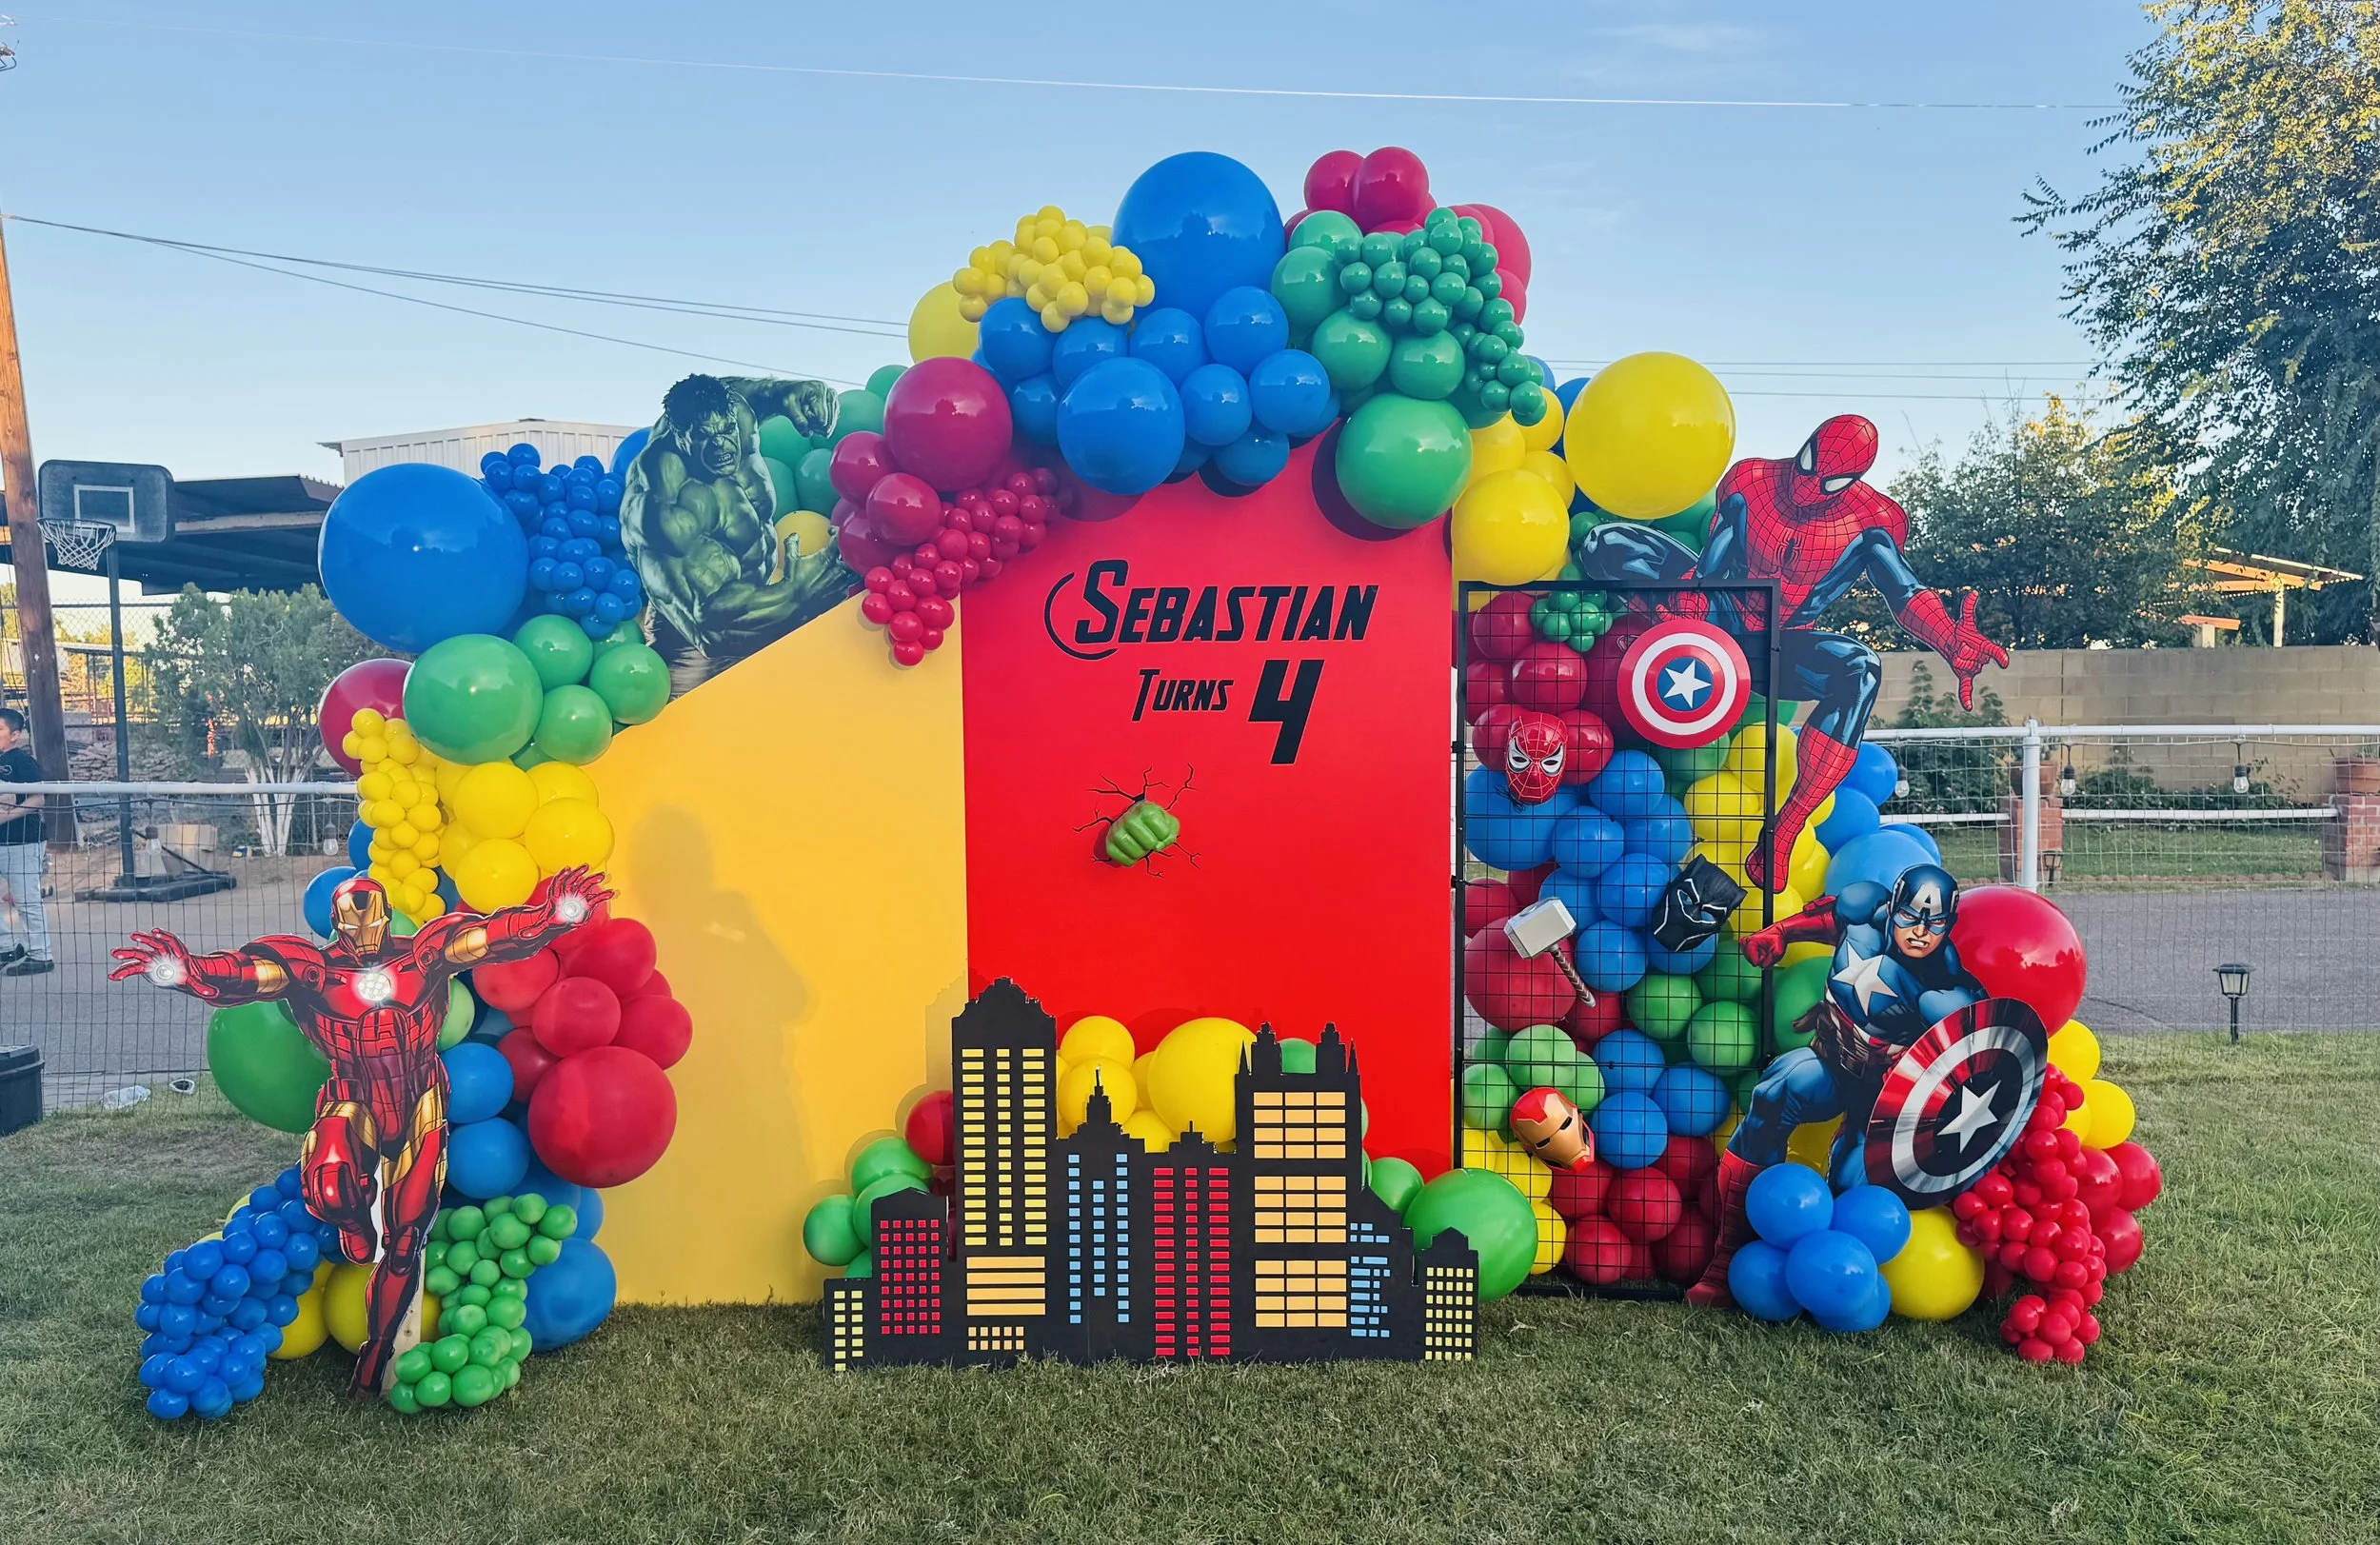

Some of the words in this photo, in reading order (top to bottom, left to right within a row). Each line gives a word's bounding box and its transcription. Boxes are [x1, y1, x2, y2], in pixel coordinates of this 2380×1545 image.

[1074, 559, 1378, 644] SEBASTIAN
[1131, 669, 1235, 722] TURNS
[1248, 660, 1325, 764] 4
[1909, 883, 1943, 916] A
